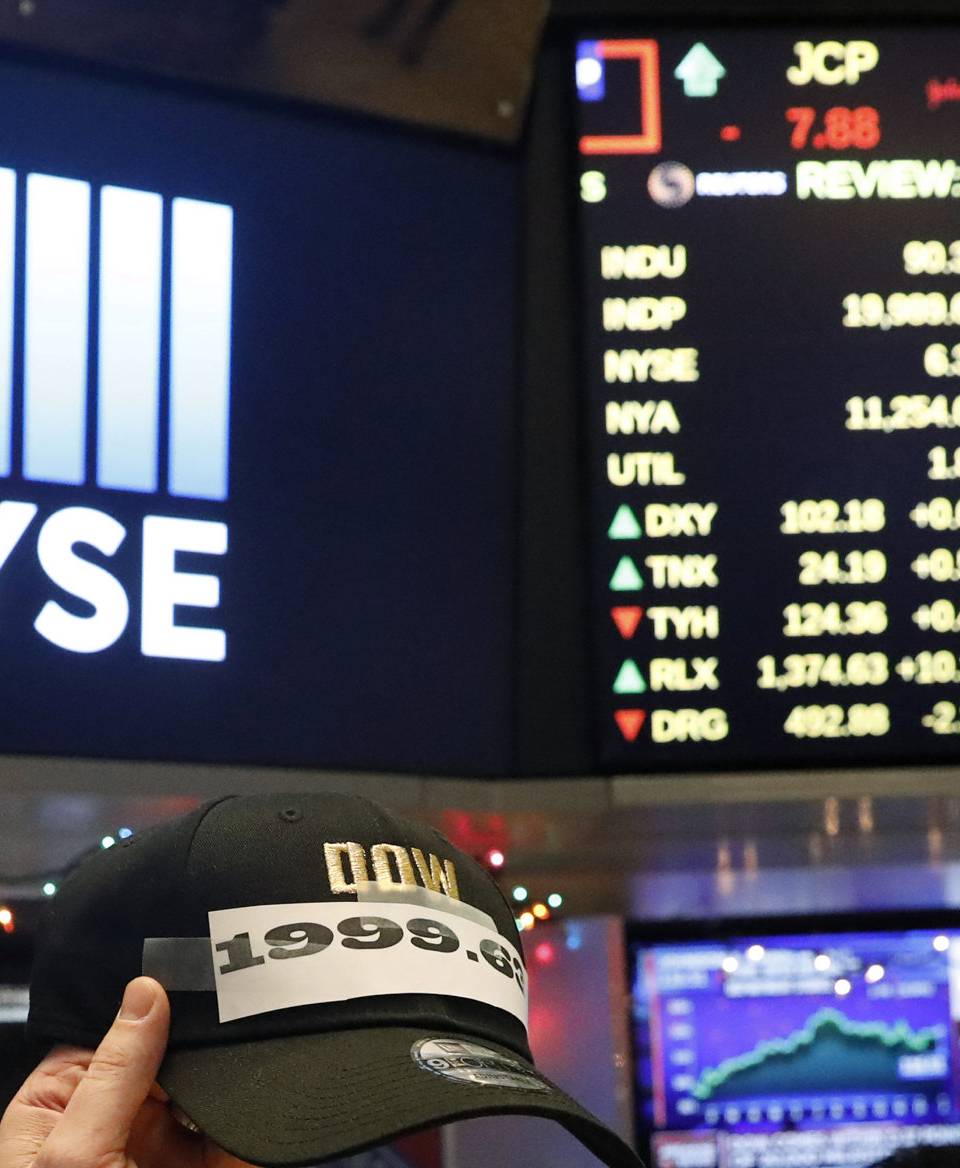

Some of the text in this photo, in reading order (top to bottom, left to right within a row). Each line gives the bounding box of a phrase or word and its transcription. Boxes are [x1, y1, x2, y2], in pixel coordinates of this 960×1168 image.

[786, 41, 879, 86] JCP
[785, 106, 881, 150] 7.88
[604, 348, 699, 383] NYSE
[605, 400, 680, 435] NYA
[645, 502, 718, 537] DXY
[647, 605, 719, 640] TYH
[650, 657, 719, 691] RLX
[323, 841, 460, 901] DOW
